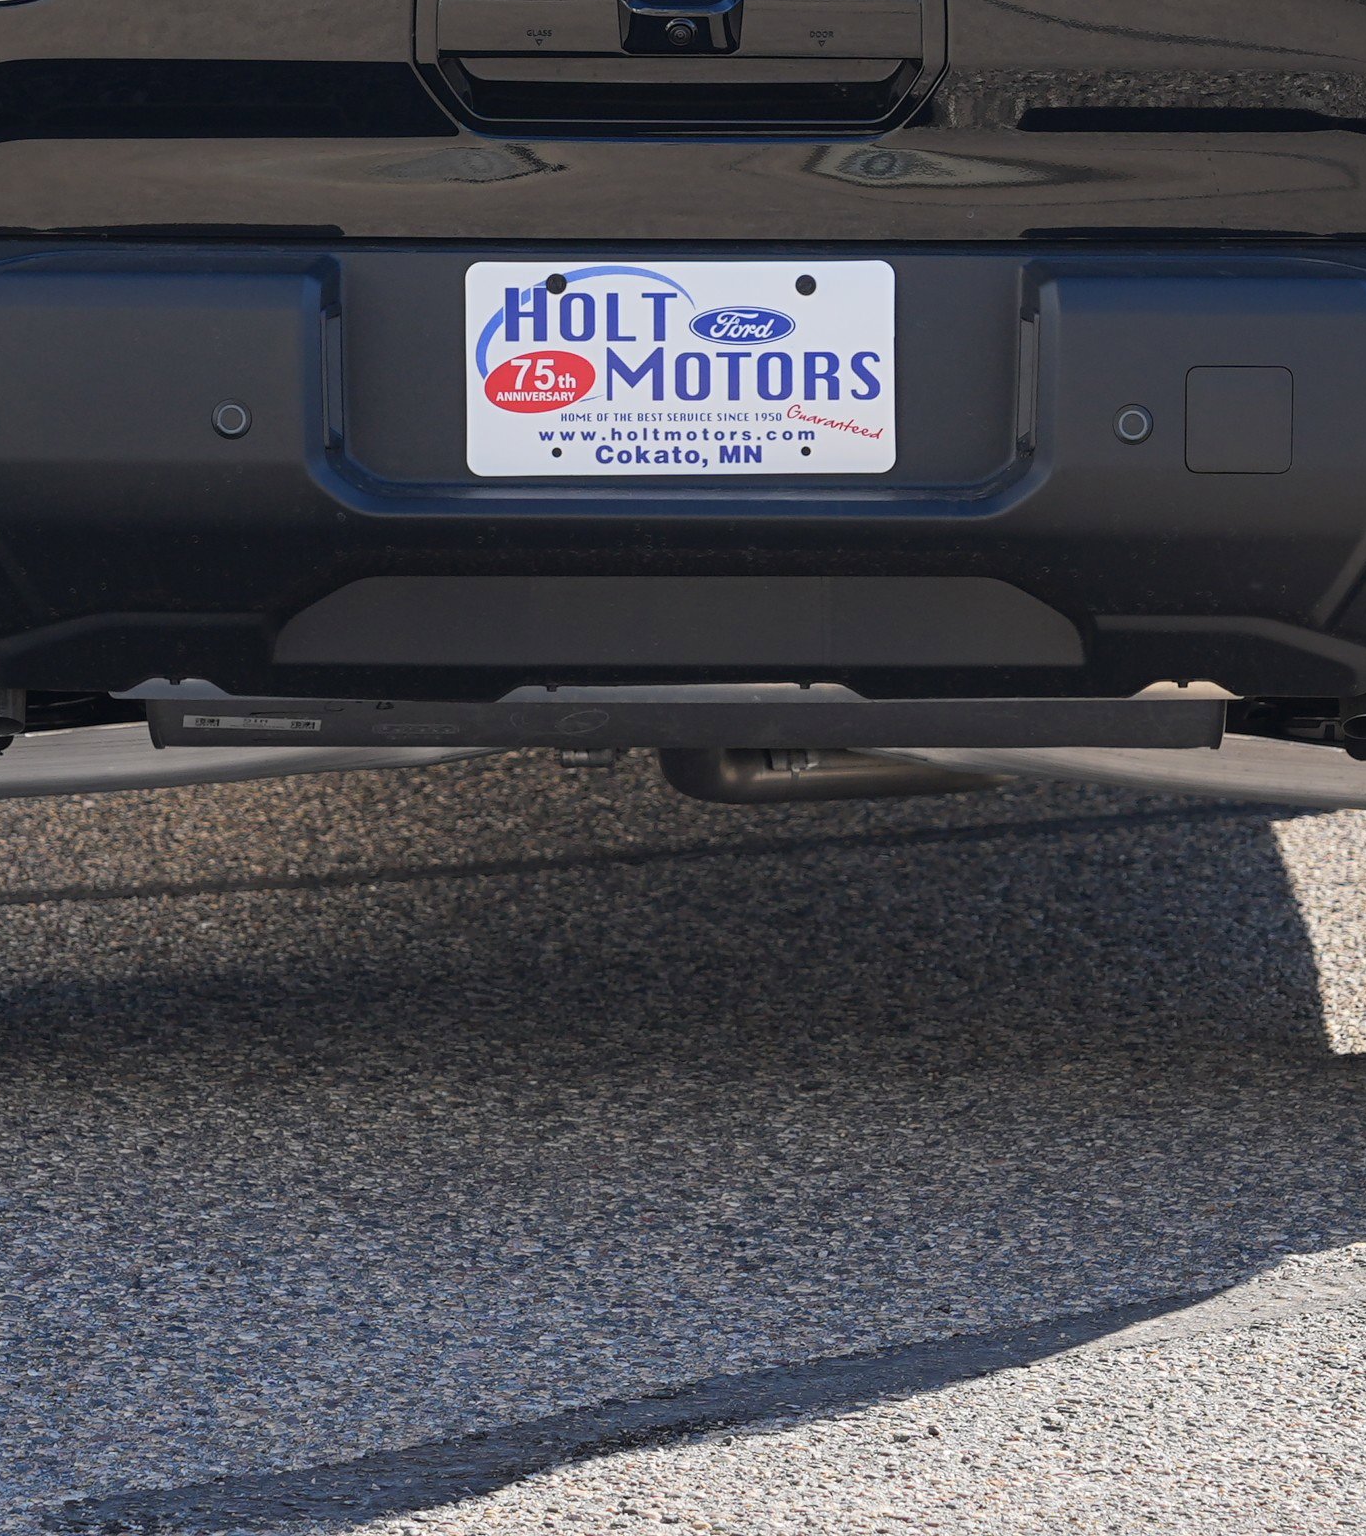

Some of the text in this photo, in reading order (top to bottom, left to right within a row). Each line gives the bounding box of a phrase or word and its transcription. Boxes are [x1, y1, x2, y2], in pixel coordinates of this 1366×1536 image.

[526, 29, 553, 37] GLASS
[809, 30, 834, 38] DOOR
[505, 287, 775, 342] HOLT Ford
[510, 358, 577, 391] 75th
[606, 347, 881, 402] MOTORS
[495, 391, 575, 403] ANNIVERSARY
[561, 412, 783, 422] HOME OF THE BEST SERVICE SINCE 1950
[786, 404, 884, 440] Guaranteed
[538, 427, 816, 442] www.holtmotors.com
[595, 445, 762, 468] Cokato, MN
